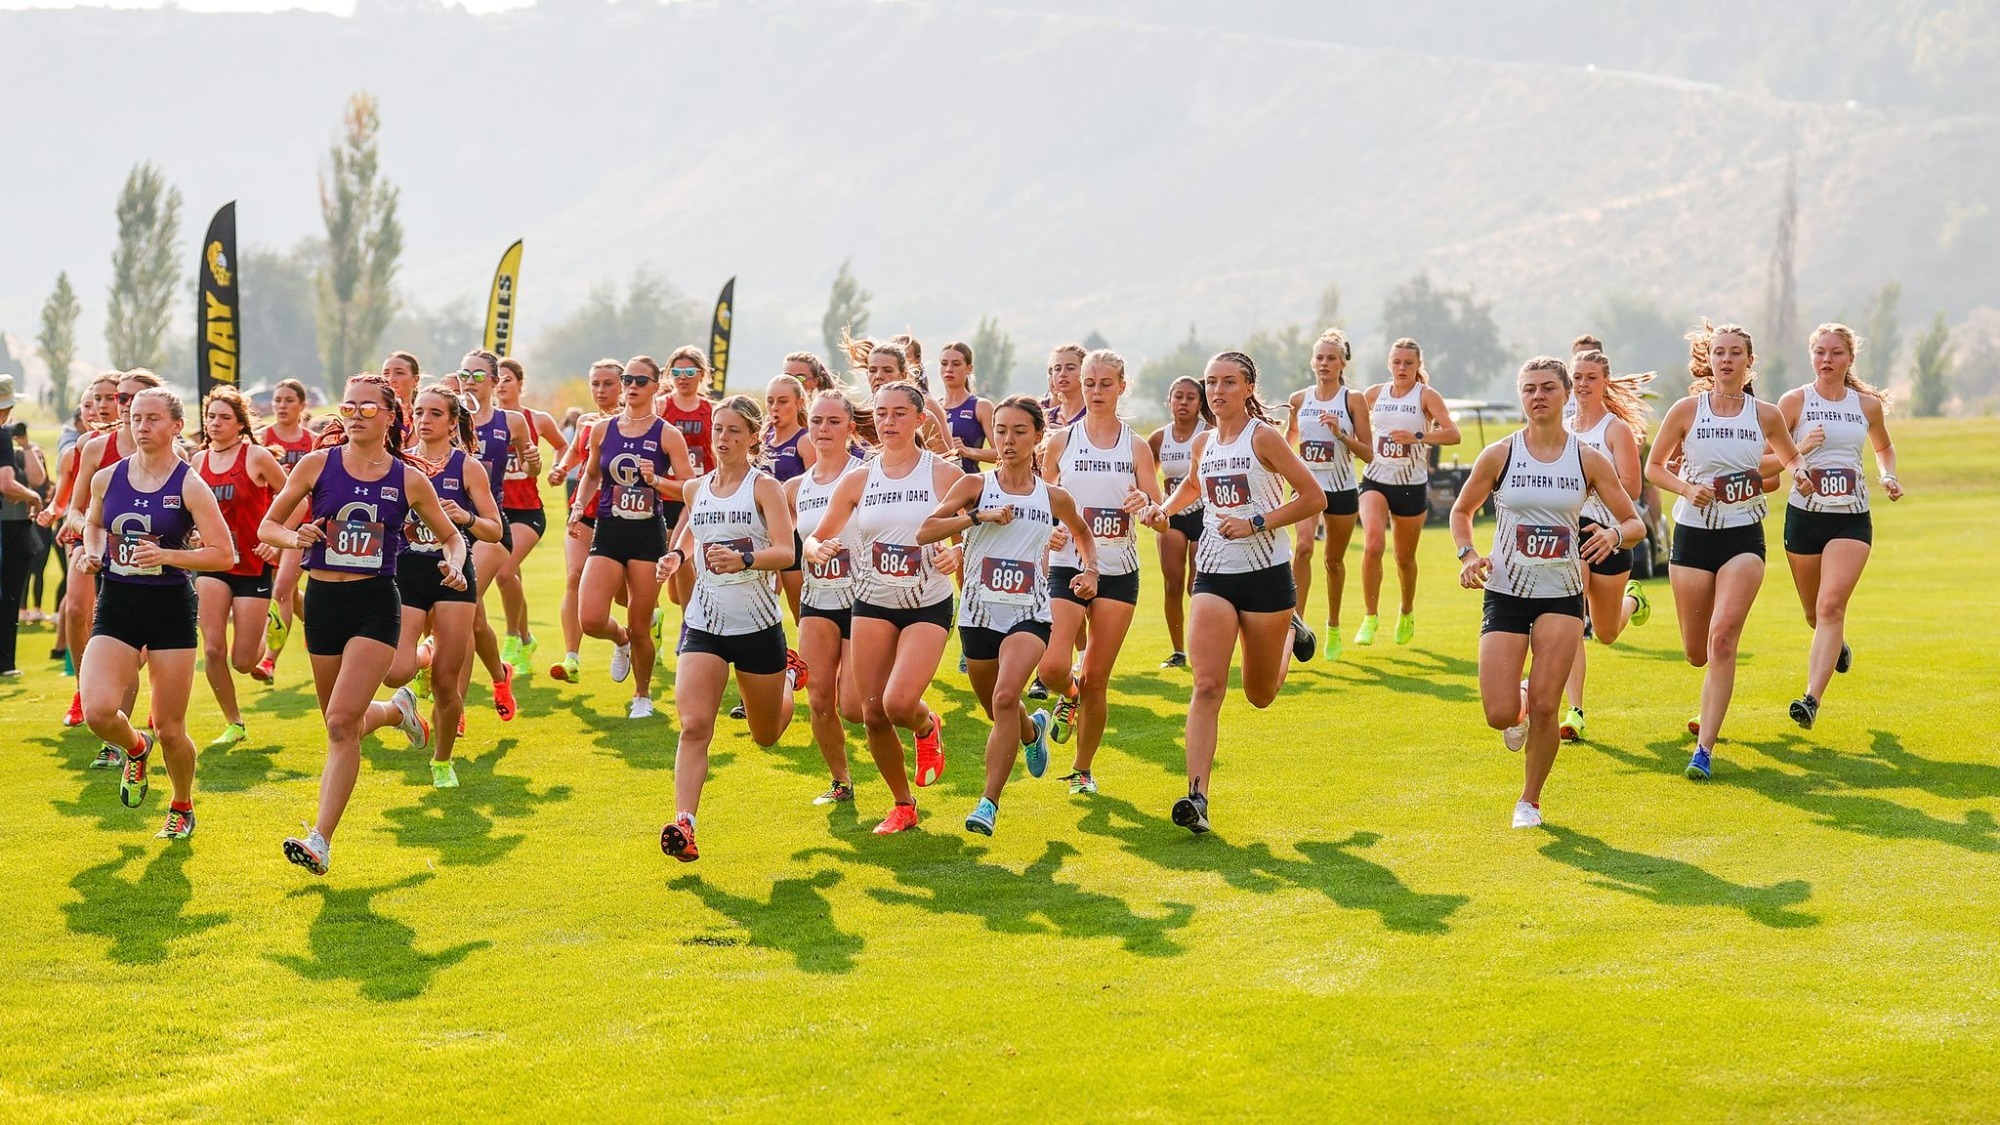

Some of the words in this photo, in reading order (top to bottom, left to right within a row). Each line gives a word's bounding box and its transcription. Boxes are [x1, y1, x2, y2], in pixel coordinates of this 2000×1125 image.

[495, 273, 511, 357] AGLES
[205, 288, 236, 382] DAY
[713, 333, 728, 392] DAY
[1301, 408, 1326, 417] SOUTHER
[1401, 405, 1416, 414] IDAHO
[1806, 411, 1842, 422] SOUTHERN
[1845, 413, 1863, 425] IDAHO
[1697, 427, 1734, 439] SOUTHERN
[1737, 428, 1757, 441] IDAHO
[1161, 451, 1185, 462] SOUTHERN
[1305, 446, 1326, 461] 874
[1383, 443, 1403, 457] 898
[505, 458, 519, 472] 41
[1075, 460, 1111, 472] SOUTHERN
[1201, 458, 1227, 475] SOUTHERN
[1230, 457, 1250, 469] IDAHO
[1511, 475, 1553, 488] SOUTHERN
[1557, 476, 1579, 491] IDAHO
[1725, 479, 1754, 502] 876
[1820, 476, 1847, 495] 880
[620, 493, 645, 510] 816
[865, 491, 902, 507] SOUTHERN
[906, 490, 929, 503] IDAHO
[1215, 484, 1240, 505] 886
[799, 496, 829, 512] SOUTHERN
[694, 511, 725, 526] SOUTHERN
[729, 511, 752, 525] IDAHO
[1028, 508, 1051, 525] IDAHO
[416, 526, 438, 543] 80
[1093, 516, 1121, 536] 885
[338, 531, 371, 553] 817
[1526, 534, 1558, 555] 877
[118, 543, 139, 564] 82
[880, 553, 909, 574] 884
[991, 567, 1024, 591] 889
